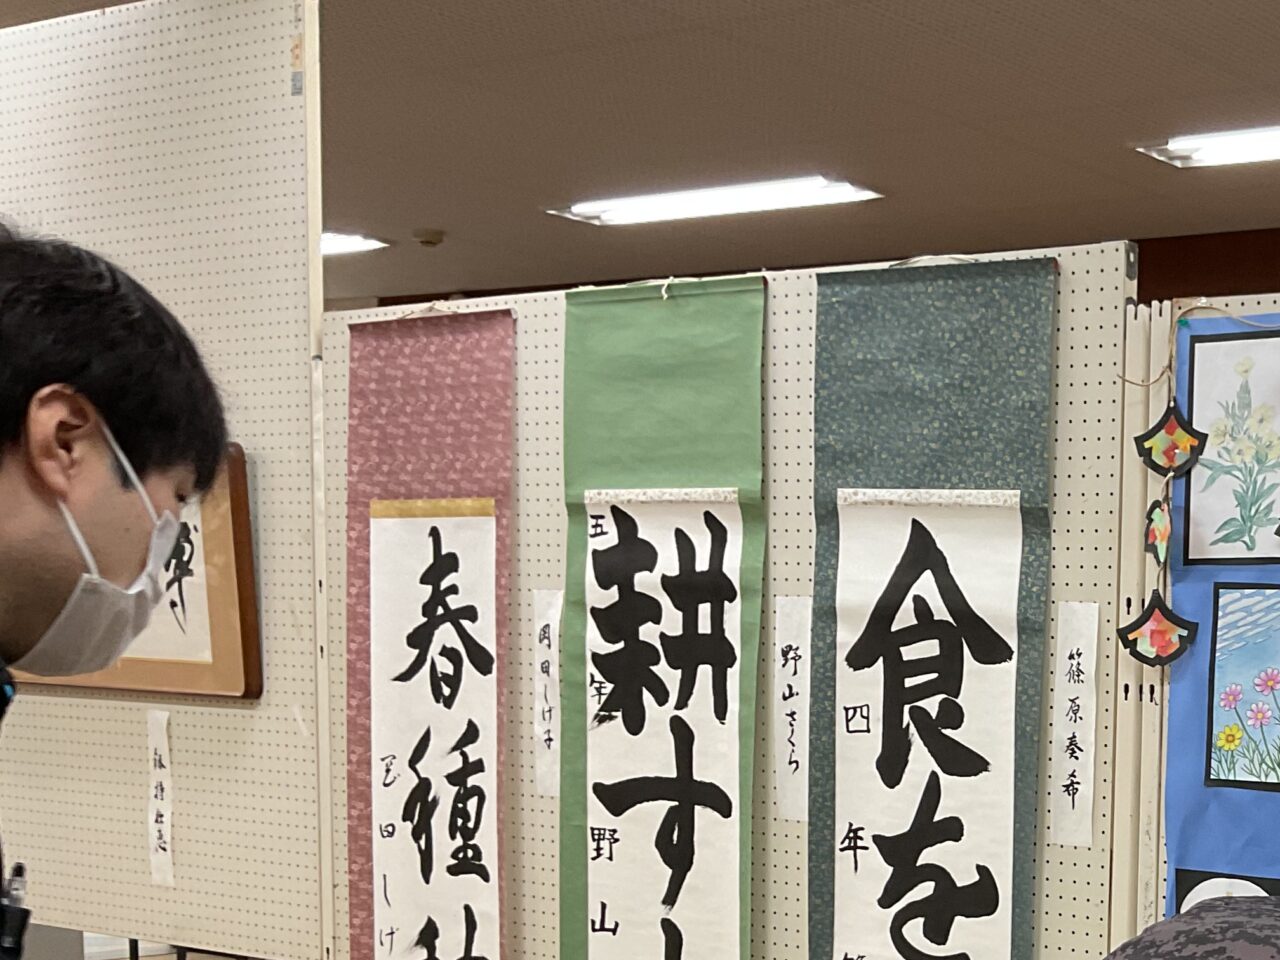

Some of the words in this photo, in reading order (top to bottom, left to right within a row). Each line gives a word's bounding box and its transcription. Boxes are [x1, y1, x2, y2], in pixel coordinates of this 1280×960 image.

[781, 643, 803, 775] 野山さくら
[1062, 648, 1086, 811] 篠原奏希
